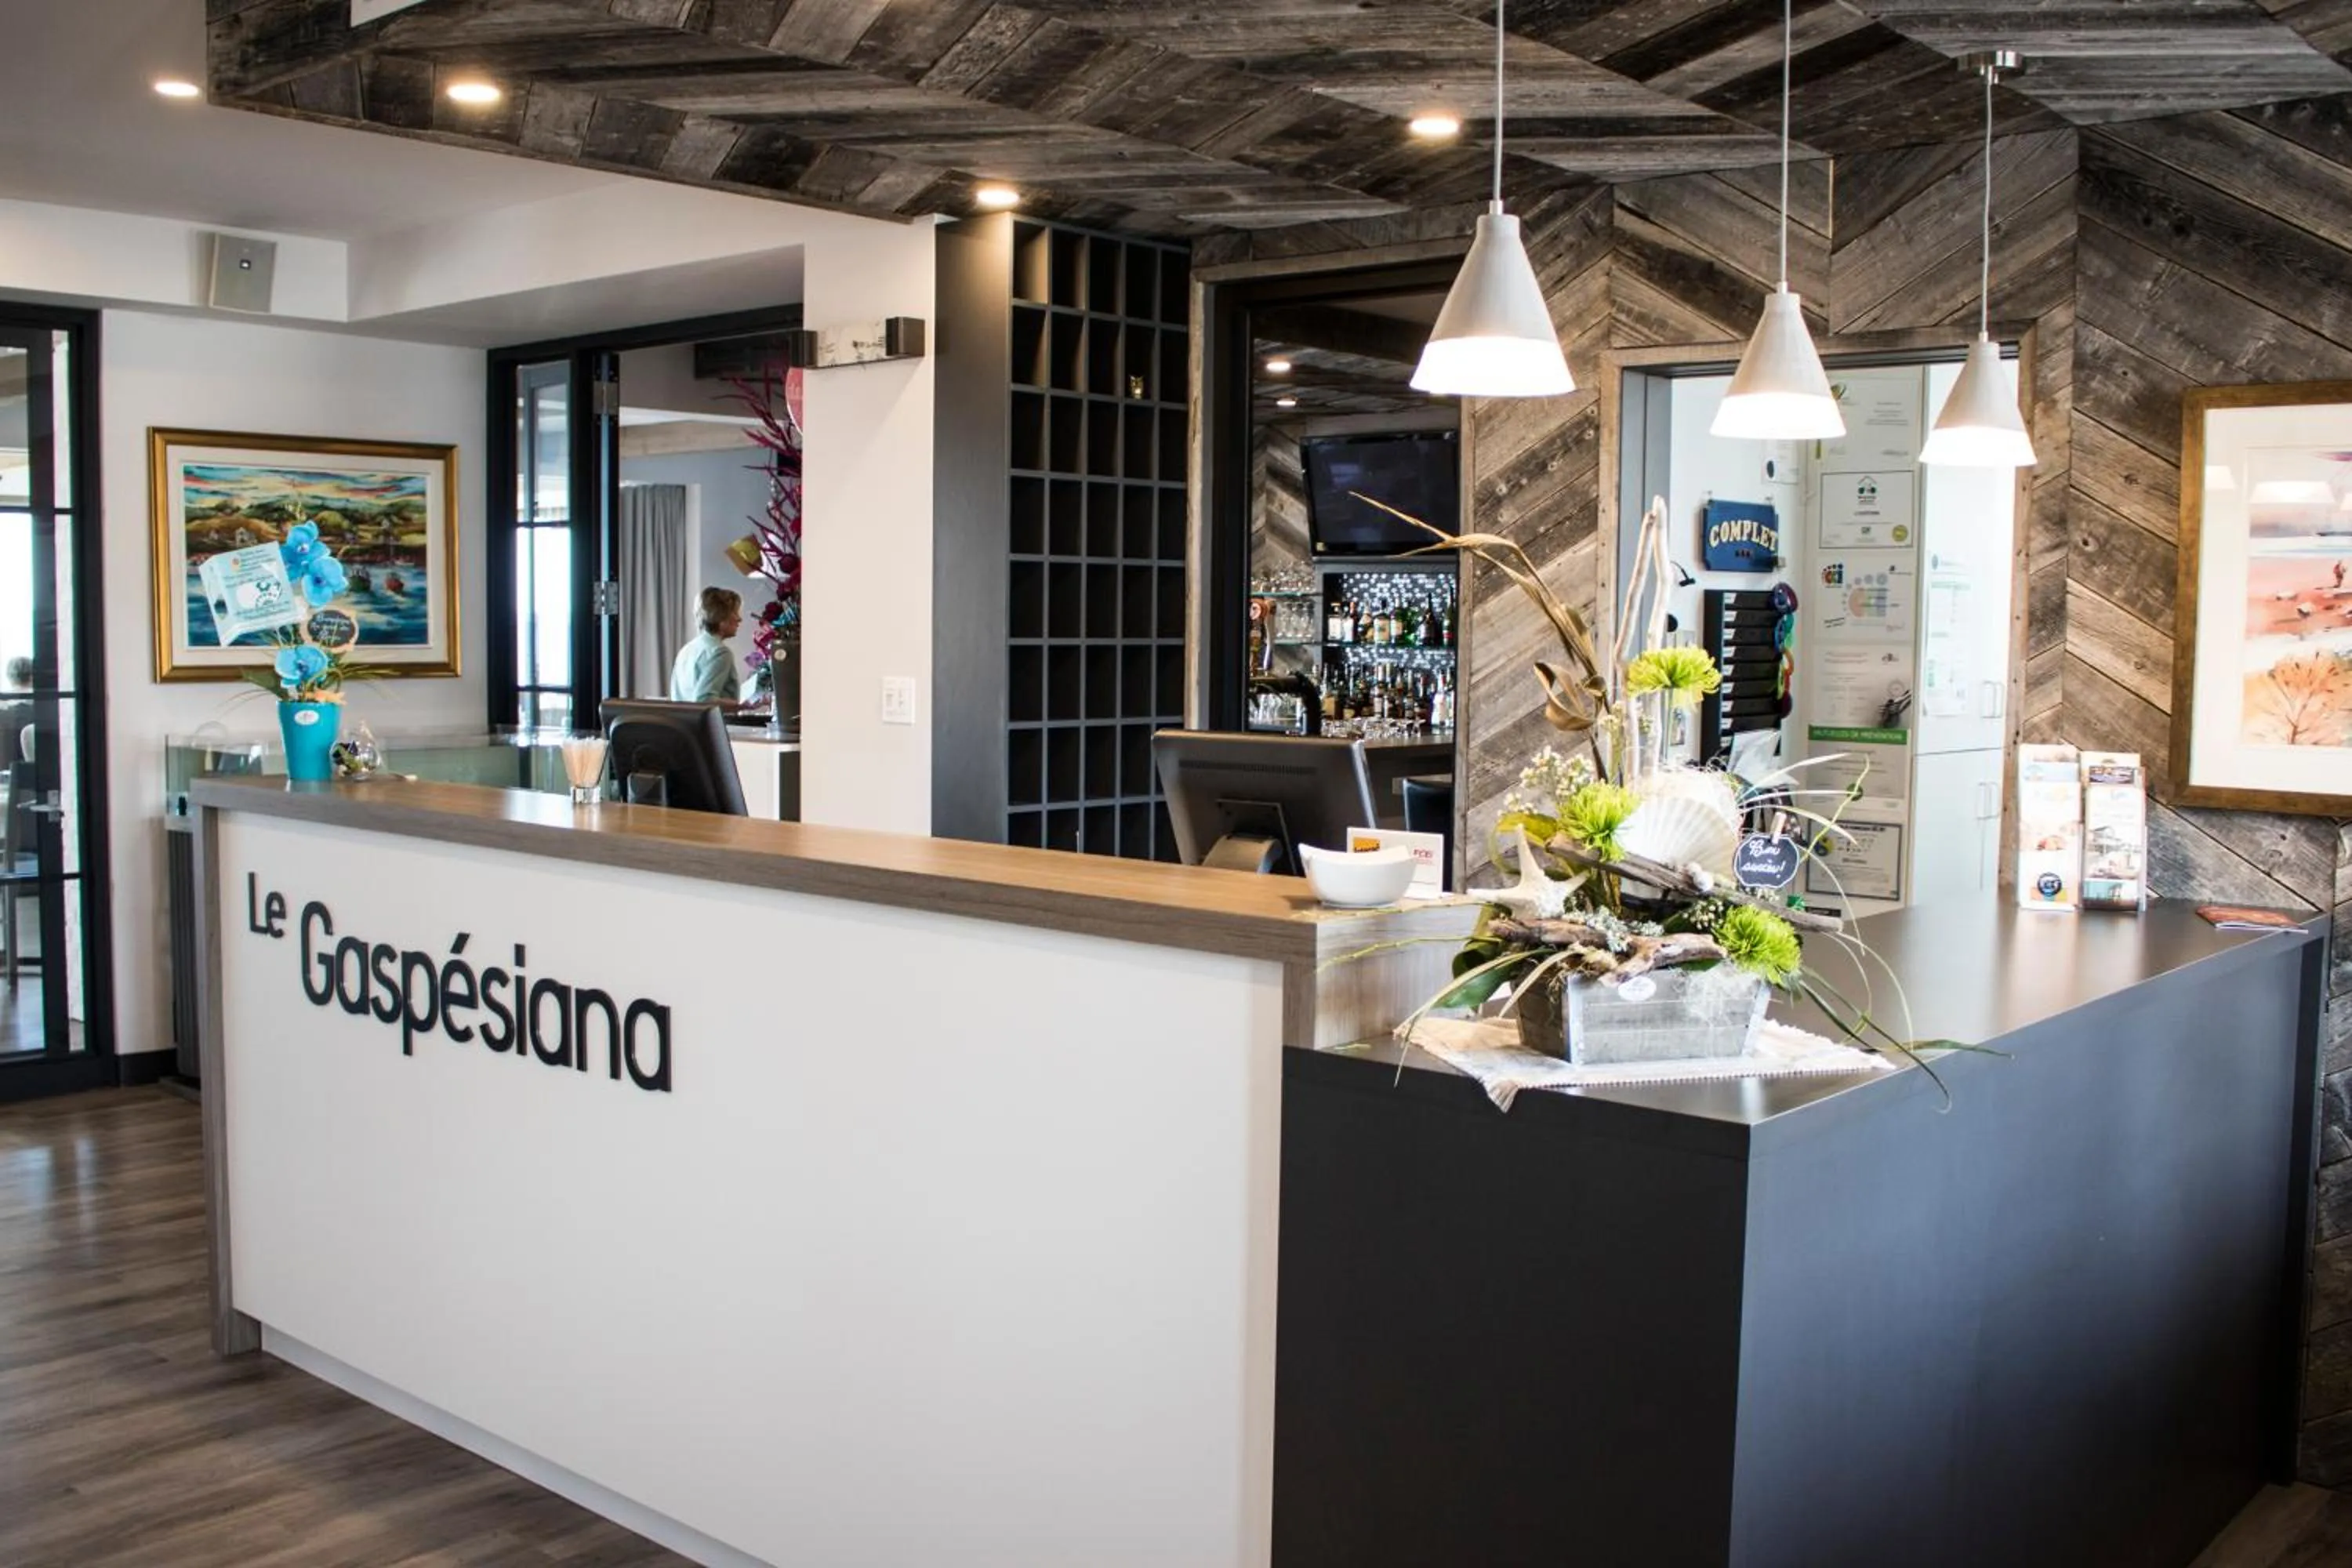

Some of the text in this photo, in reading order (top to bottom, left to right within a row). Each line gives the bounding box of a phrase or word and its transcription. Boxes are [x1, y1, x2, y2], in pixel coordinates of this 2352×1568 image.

[1710, 520, 1776, 551] COMPLET
[248, 872, 672, 1092] Le Gaspésiana
